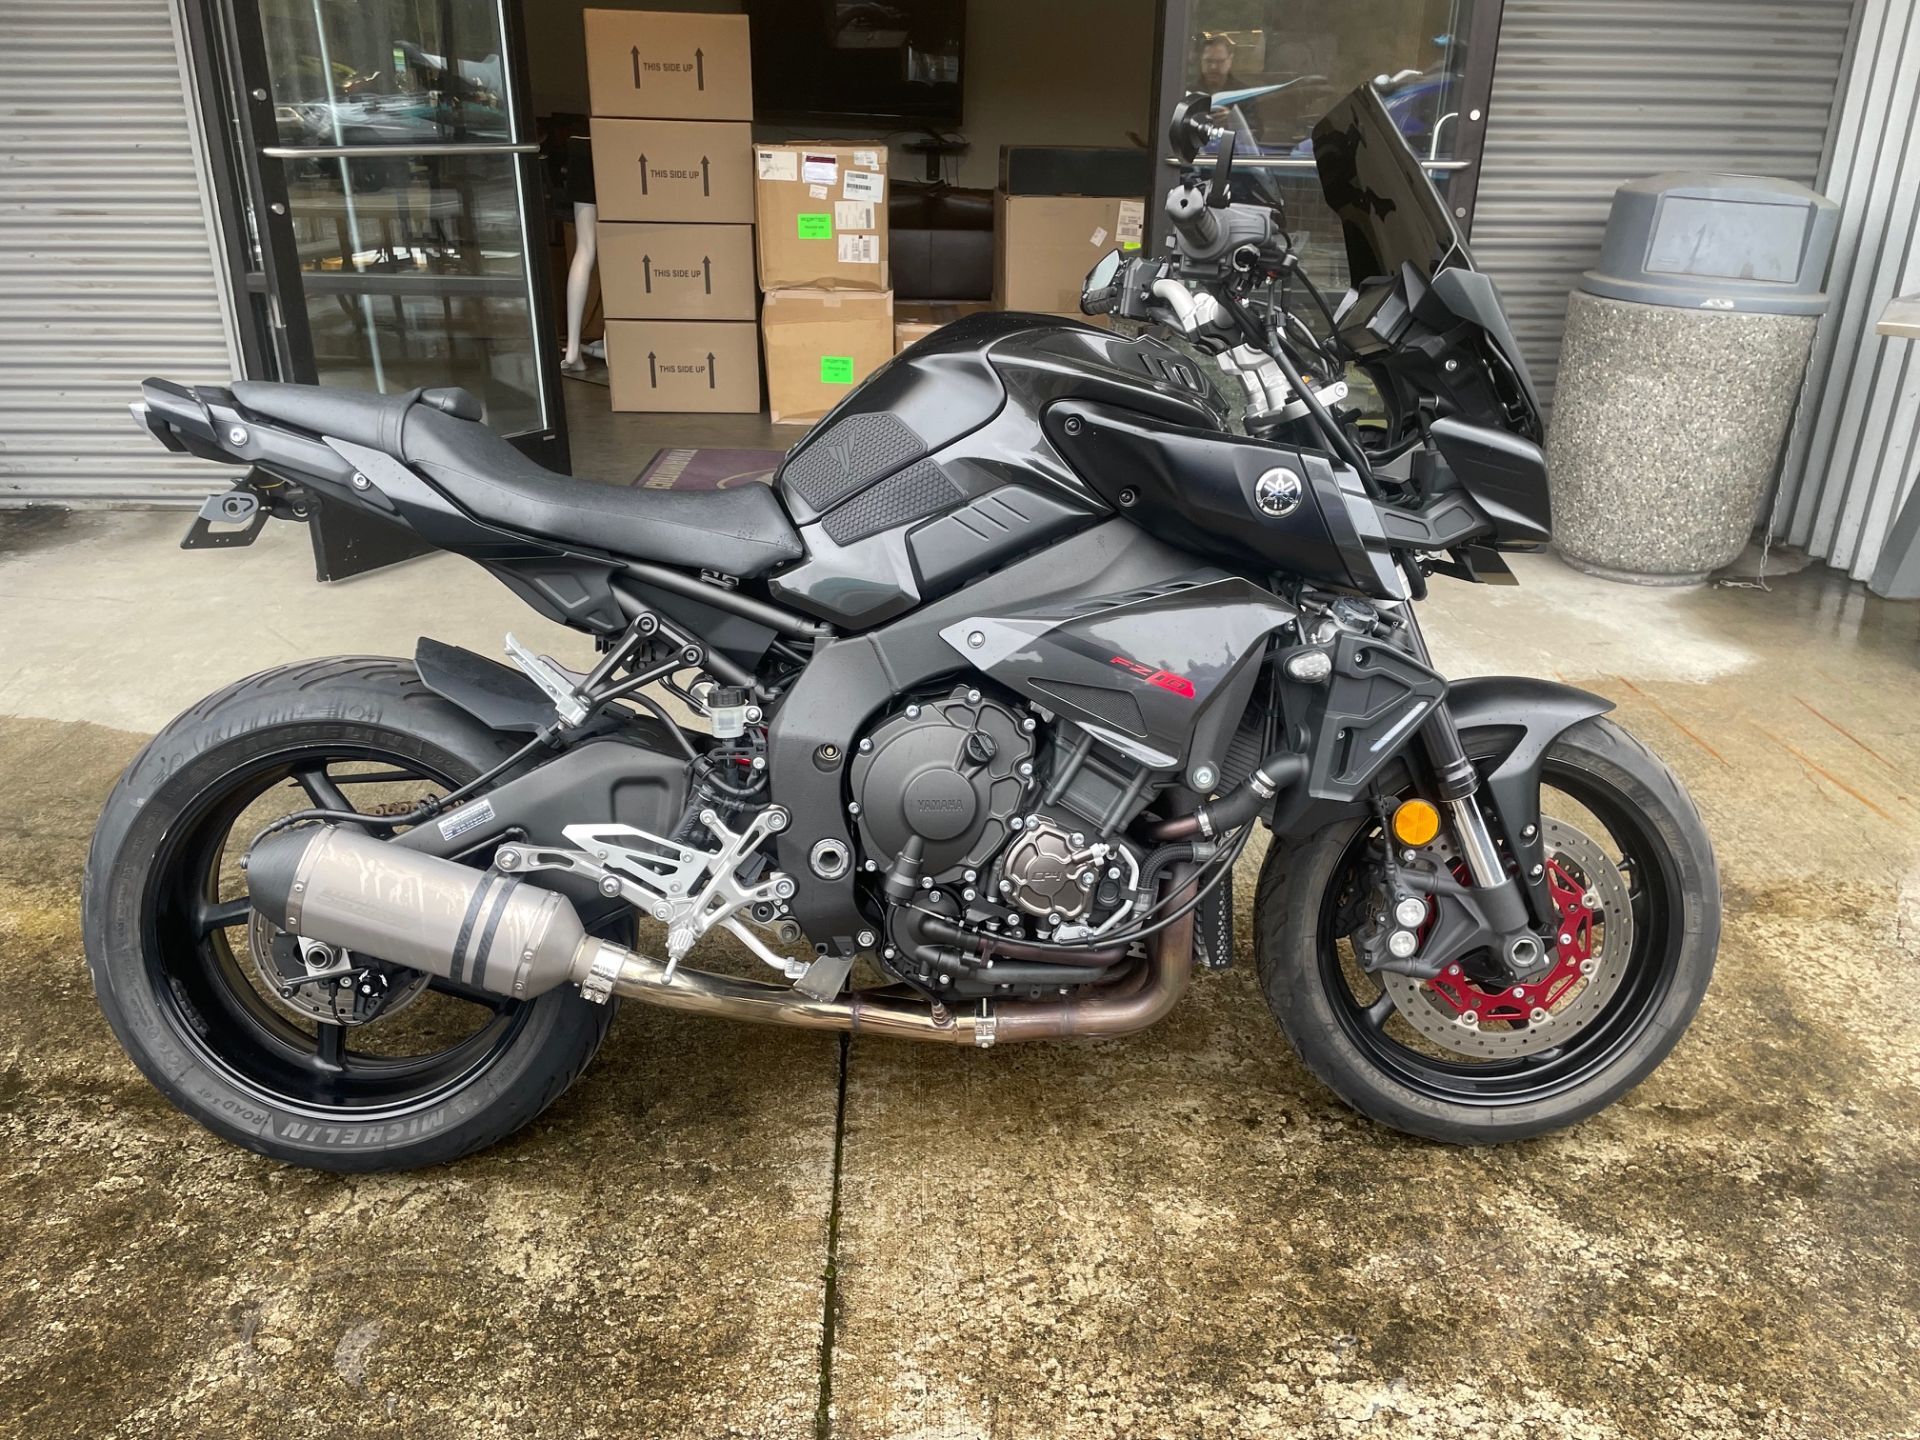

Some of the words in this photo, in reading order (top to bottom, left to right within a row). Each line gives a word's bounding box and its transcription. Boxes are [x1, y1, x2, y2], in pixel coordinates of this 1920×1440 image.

[643, 62, 661, 72] THIS
[663, 63, 681, 72] SIDE
[683, 64, 694, 73] UP
[650, 169, 668, 178] THIS
[670, 170, 687, 179] SIDE
[689, 170, 699, 179] UP
[654, 269, 671, 278] THIS
[672, 269, 689, 278] SIDE
[691, 270, 701, 278] UP
[660, 365, 675, 373] THIS
[677, 365, 694, 373] SIDE
[695, 365, 706, 373] UP
[917, 799, 965, 813] YAMAHA
[222, 1100, 266, 1126] ROAD
[281, 1109, 447, 1146] MICHELIN
